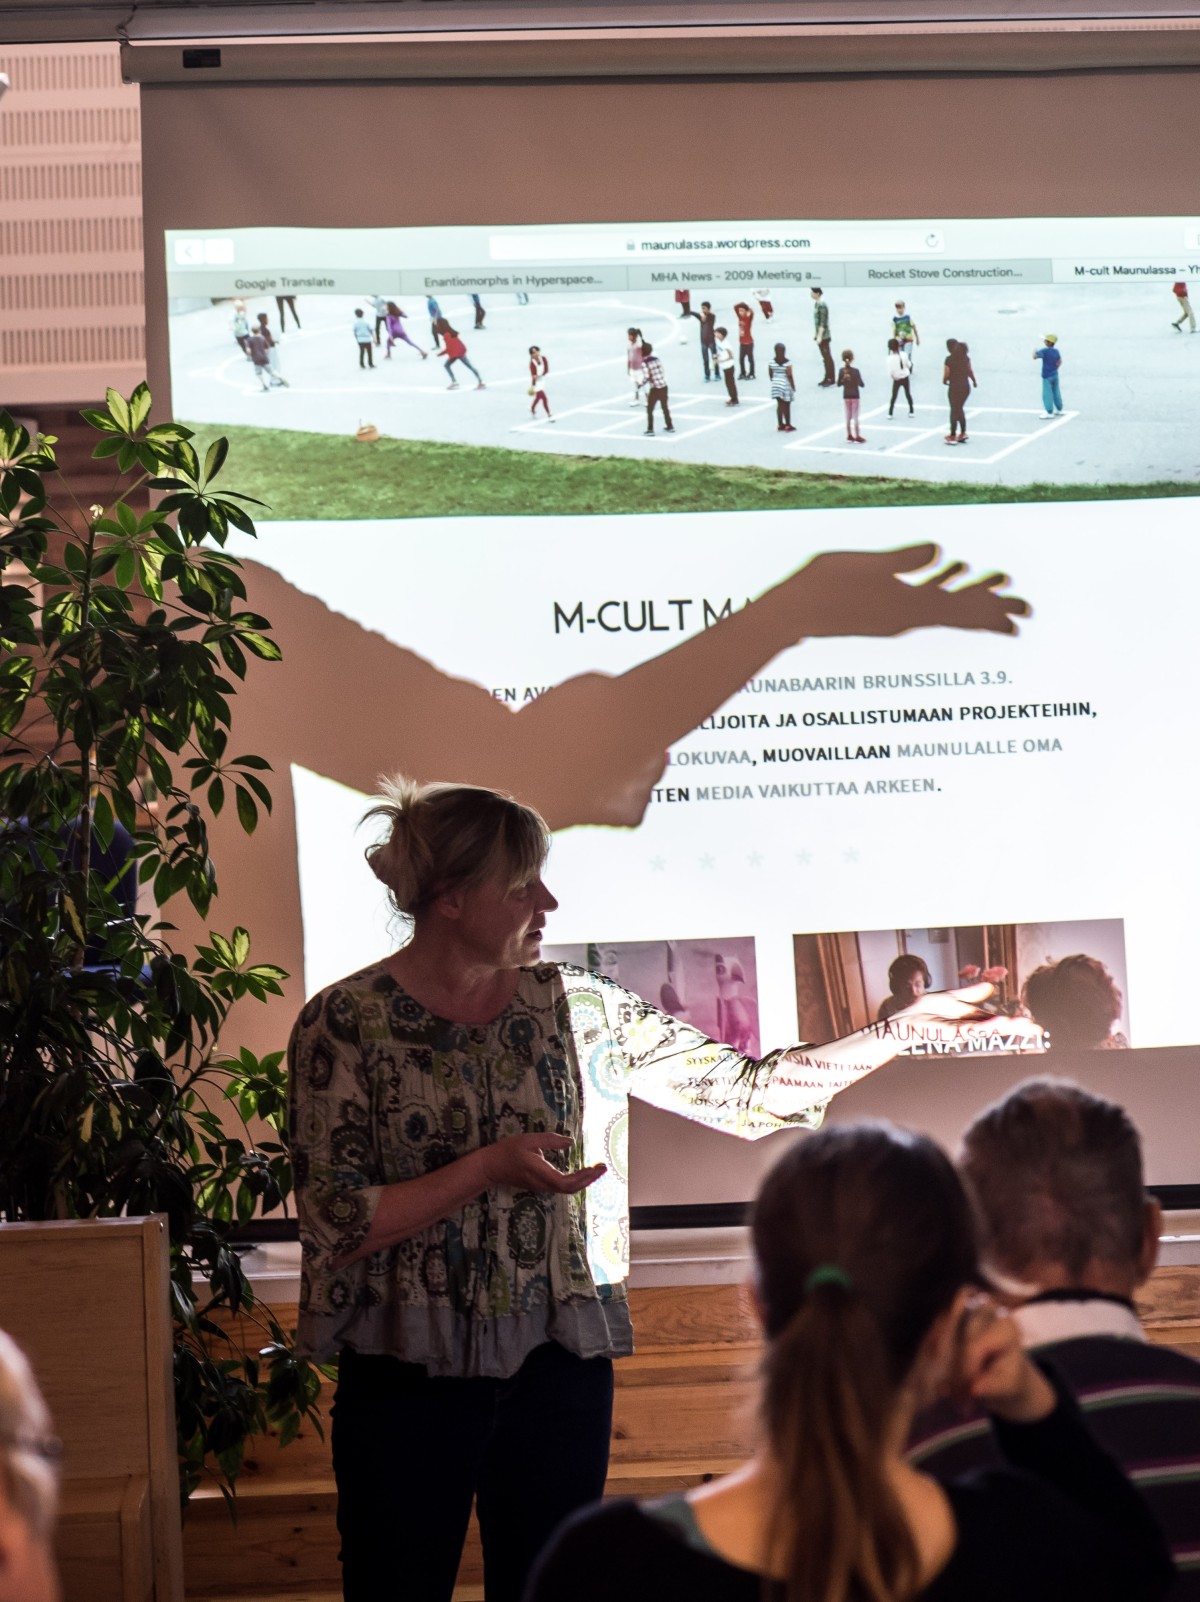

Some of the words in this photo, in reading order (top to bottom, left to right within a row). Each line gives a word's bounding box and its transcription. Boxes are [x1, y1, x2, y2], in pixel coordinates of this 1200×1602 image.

[641, 238, 811, 250] maunulassa.wordpress.com
[651, 272, 678, 282] MHA
[682, 271, 712, 281] News
[725, 270, 753, 281] 2009
[758, 270, 802, 282] Meeting
[868, 268, 906, 279] Rocket
[909, 267, 940, 279] Stove
[1075, 265, 1109, 275] M-cult
[1113, 265, 1176, 275] Maunulassa
[235, 278, 276, 290] Google
[281, 276, 335, 287] Translate
[425, 275, 509, 288] Enantiomorphs
[513, 274, 523, 285] in
[553, 600, 692, 634] M-CULT
[523, 686, 554, 701] AV
[864, 672, 975, 689] BRUNSSILLA
[980, 671, 1013, 685] 3.9.
[775, 713, 797, 728] JA
[802, 707, 953, 727] OSALLISTUMAAN
[960, 702, 1097, 721] PROJEKTEIHIN,
[763, 744, 891, 762] MUOVAILLAAN
[898, 740, 1017, 758] MAUNULALLE
[1023, 738, 1063, 753] OMA
[696, 784, 754, 801] MEDIA
[759, 781, 858, 799] VAIKUTTAA
